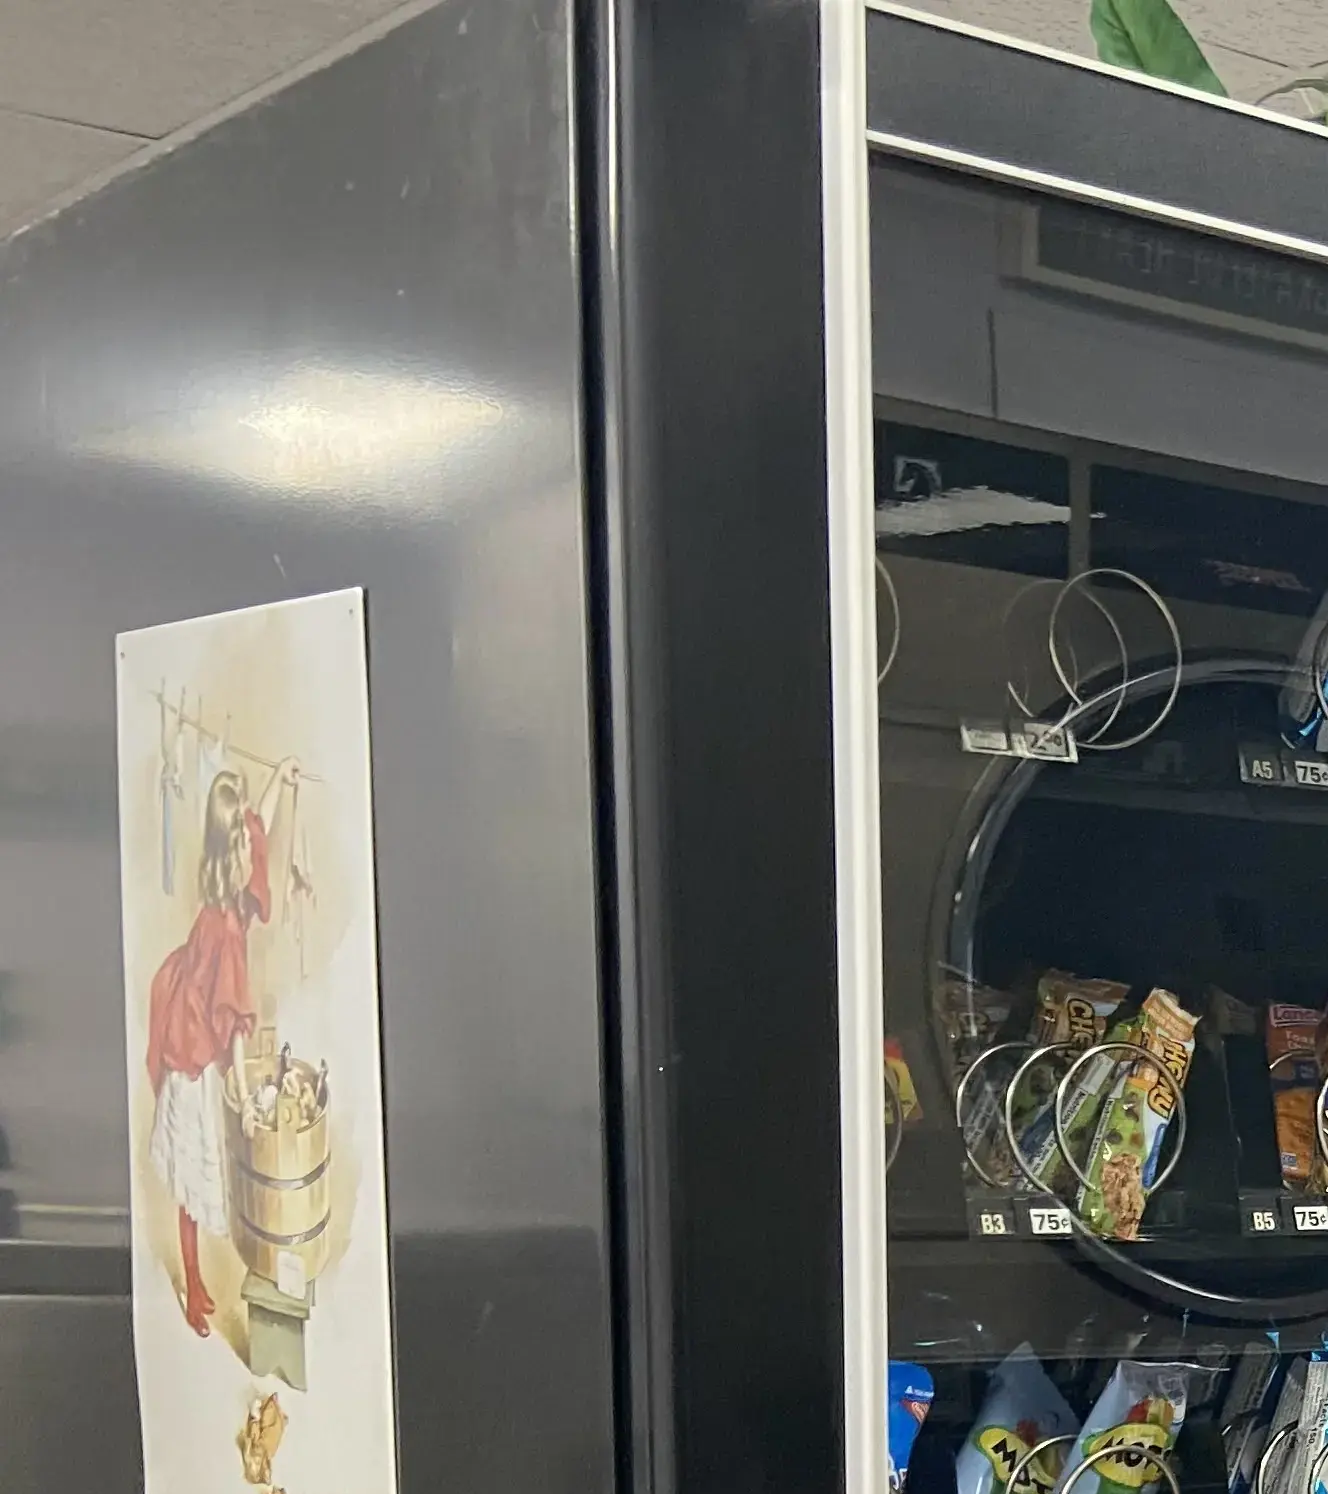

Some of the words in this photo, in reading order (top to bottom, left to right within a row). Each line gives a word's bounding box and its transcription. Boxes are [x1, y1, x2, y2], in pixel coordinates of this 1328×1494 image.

[1252, 760, 1273, 778] A5
[981, 1213, 1005, 1234] B3
[1033, 1212, 1069, 1231] 75¢
[1253, 1212, 1275, 1230] B5
[1299, 1212, 1327, 1228] 75¢
